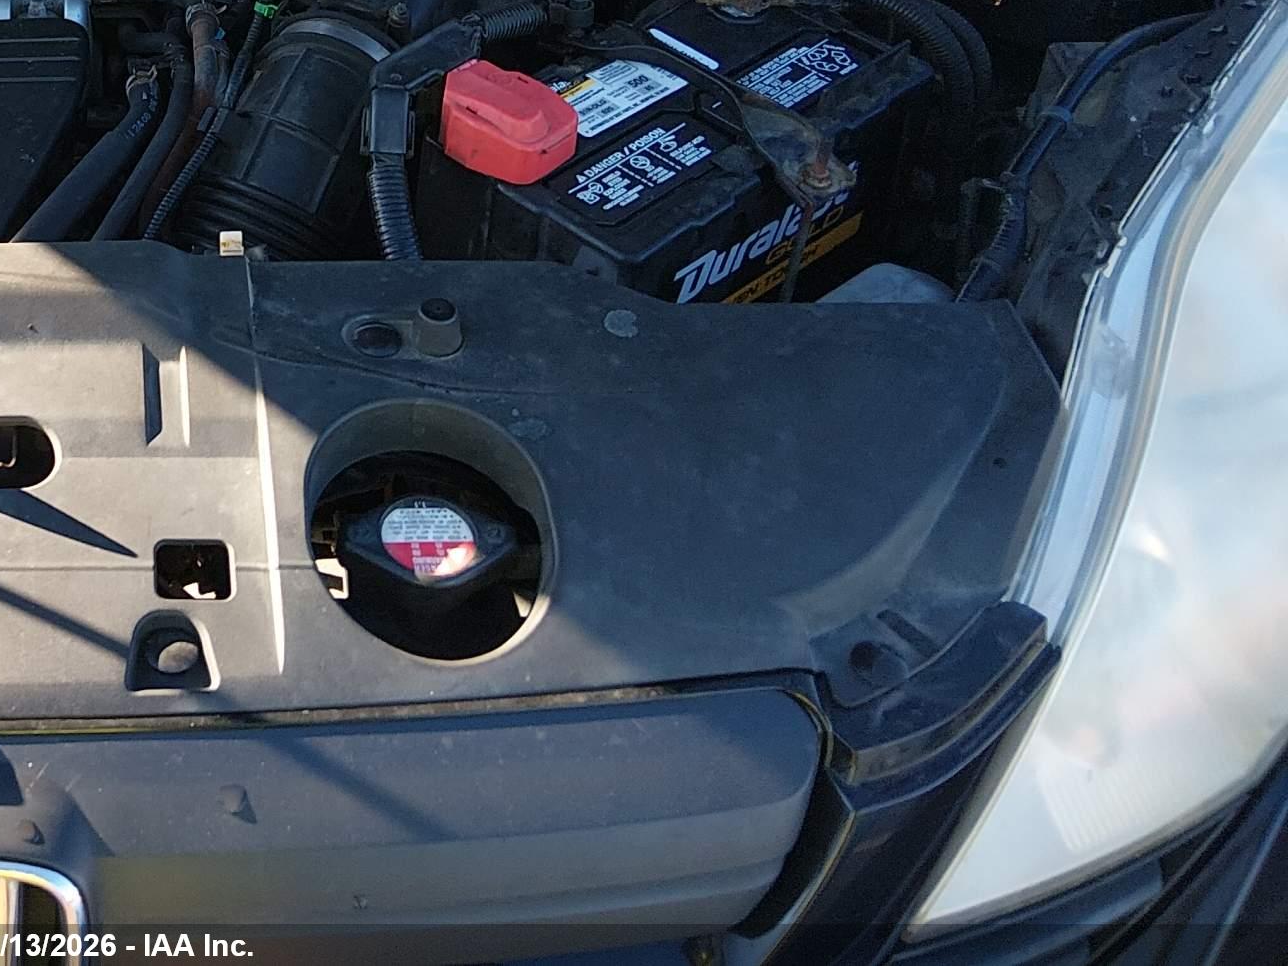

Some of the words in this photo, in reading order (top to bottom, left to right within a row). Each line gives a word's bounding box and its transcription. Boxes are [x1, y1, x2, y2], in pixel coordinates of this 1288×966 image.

[628, 74, 650, 88] 500
[584, 151, 626, 178] DANGER
[628, 127, 667, 152] POISON
[673, 191, 849, 304] Durala
